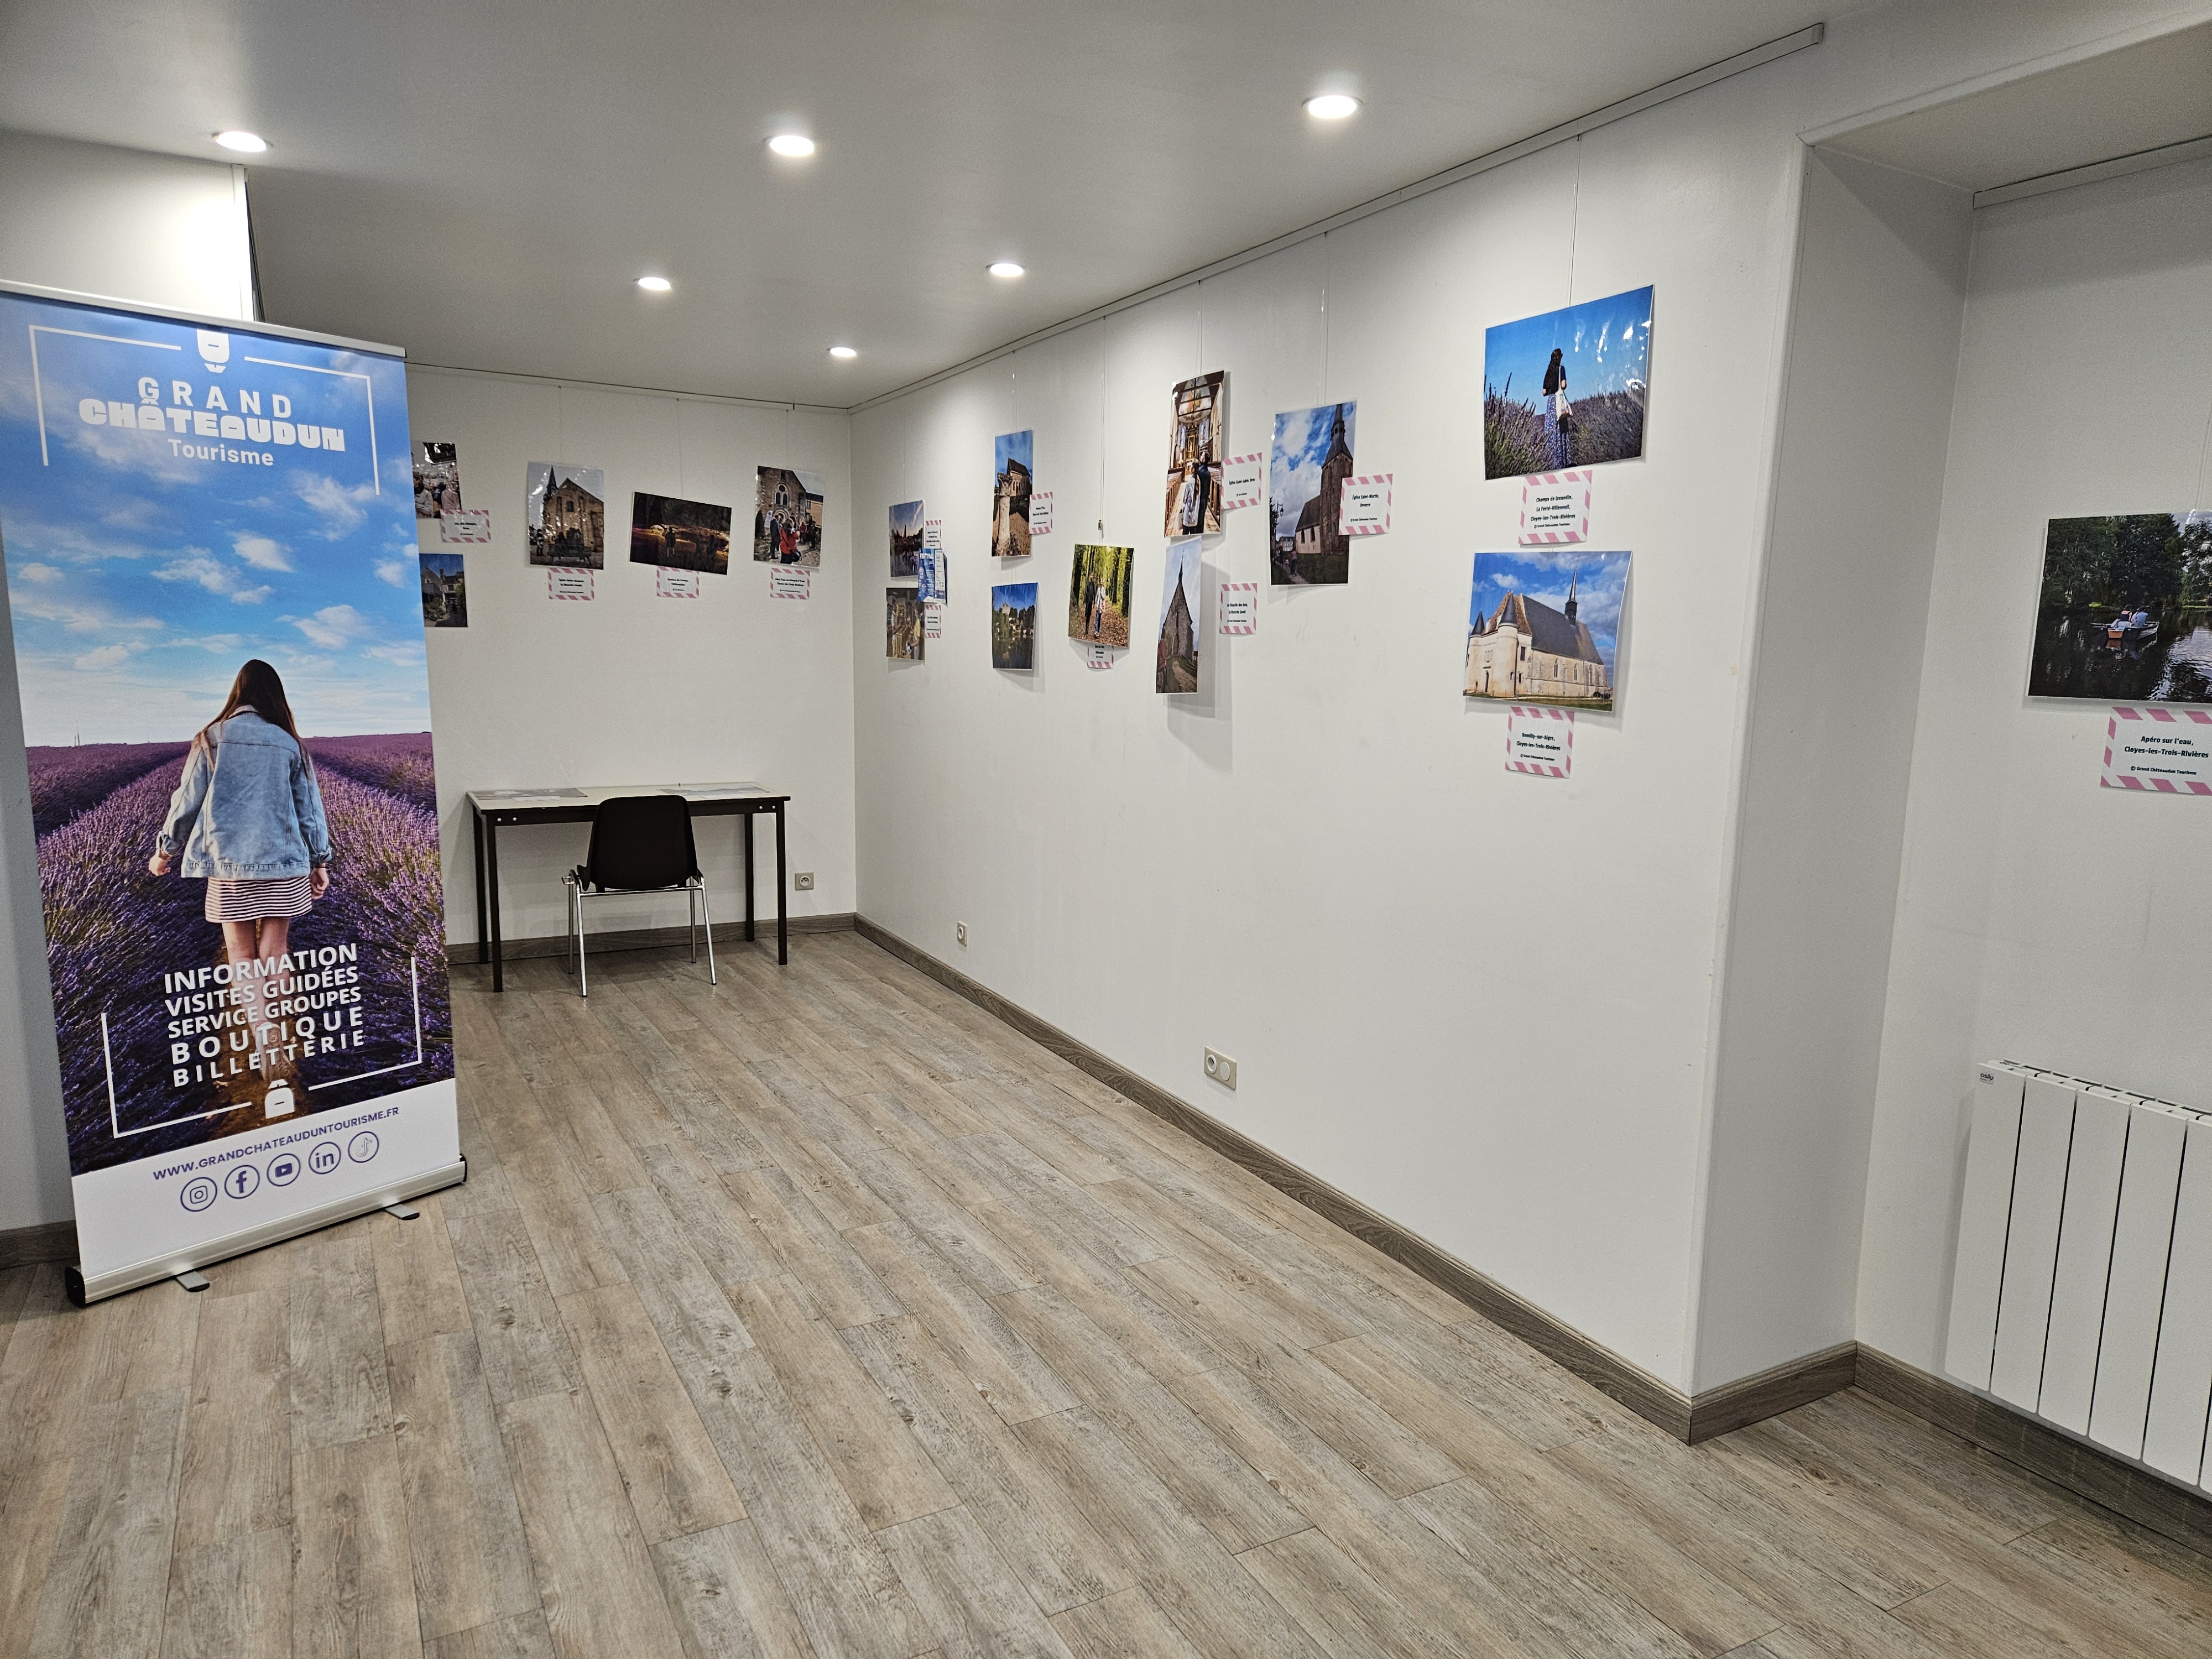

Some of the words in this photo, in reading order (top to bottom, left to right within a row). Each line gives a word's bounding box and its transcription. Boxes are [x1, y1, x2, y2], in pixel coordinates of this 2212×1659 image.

[138, 377, 291, 418] GRAND
[79, 397, 346, 452] CHÂTEAUDUN
[168, 439, 274, 466] Tourisme
[2124, 746, 2209, 758] Cloyes-les-Trois-Rivières
[164, 943, 357, 994] INFORMATION
[164, 984, 255, 1017] VISITES
[263, 966, 358, 999] GUIDÉES
[168, 1006, 259, 1039] SERVICE
[265, 986, 361, 1019] GROUPES
[171, 1006, 363, 1065] BOUTIQUE
[173, 1030, 364, 1088] BILLETTERIE
[153, 1107, 399, 1181] WWW.GRANDCHATEAUDUNTOURISME.FR
